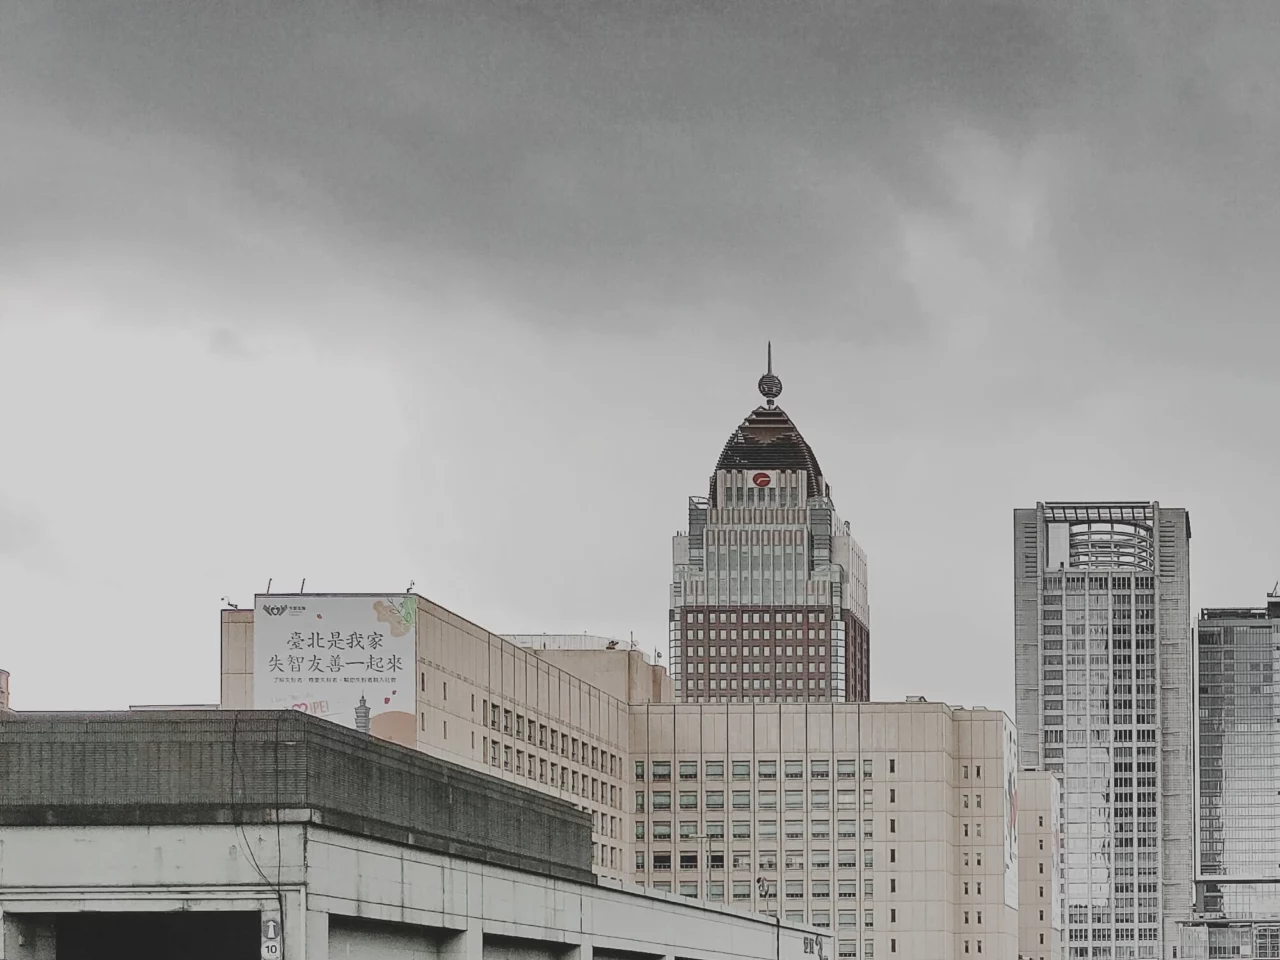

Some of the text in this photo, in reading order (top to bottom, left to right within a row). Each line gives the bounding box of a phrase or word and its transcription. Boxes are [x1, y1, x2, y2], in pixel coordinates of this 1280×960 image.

[286, 631, 385, 651] 臺北是我家
[268, 654, 404, 673] 失智友善一起來
[265, 944, 278, 954] 10
